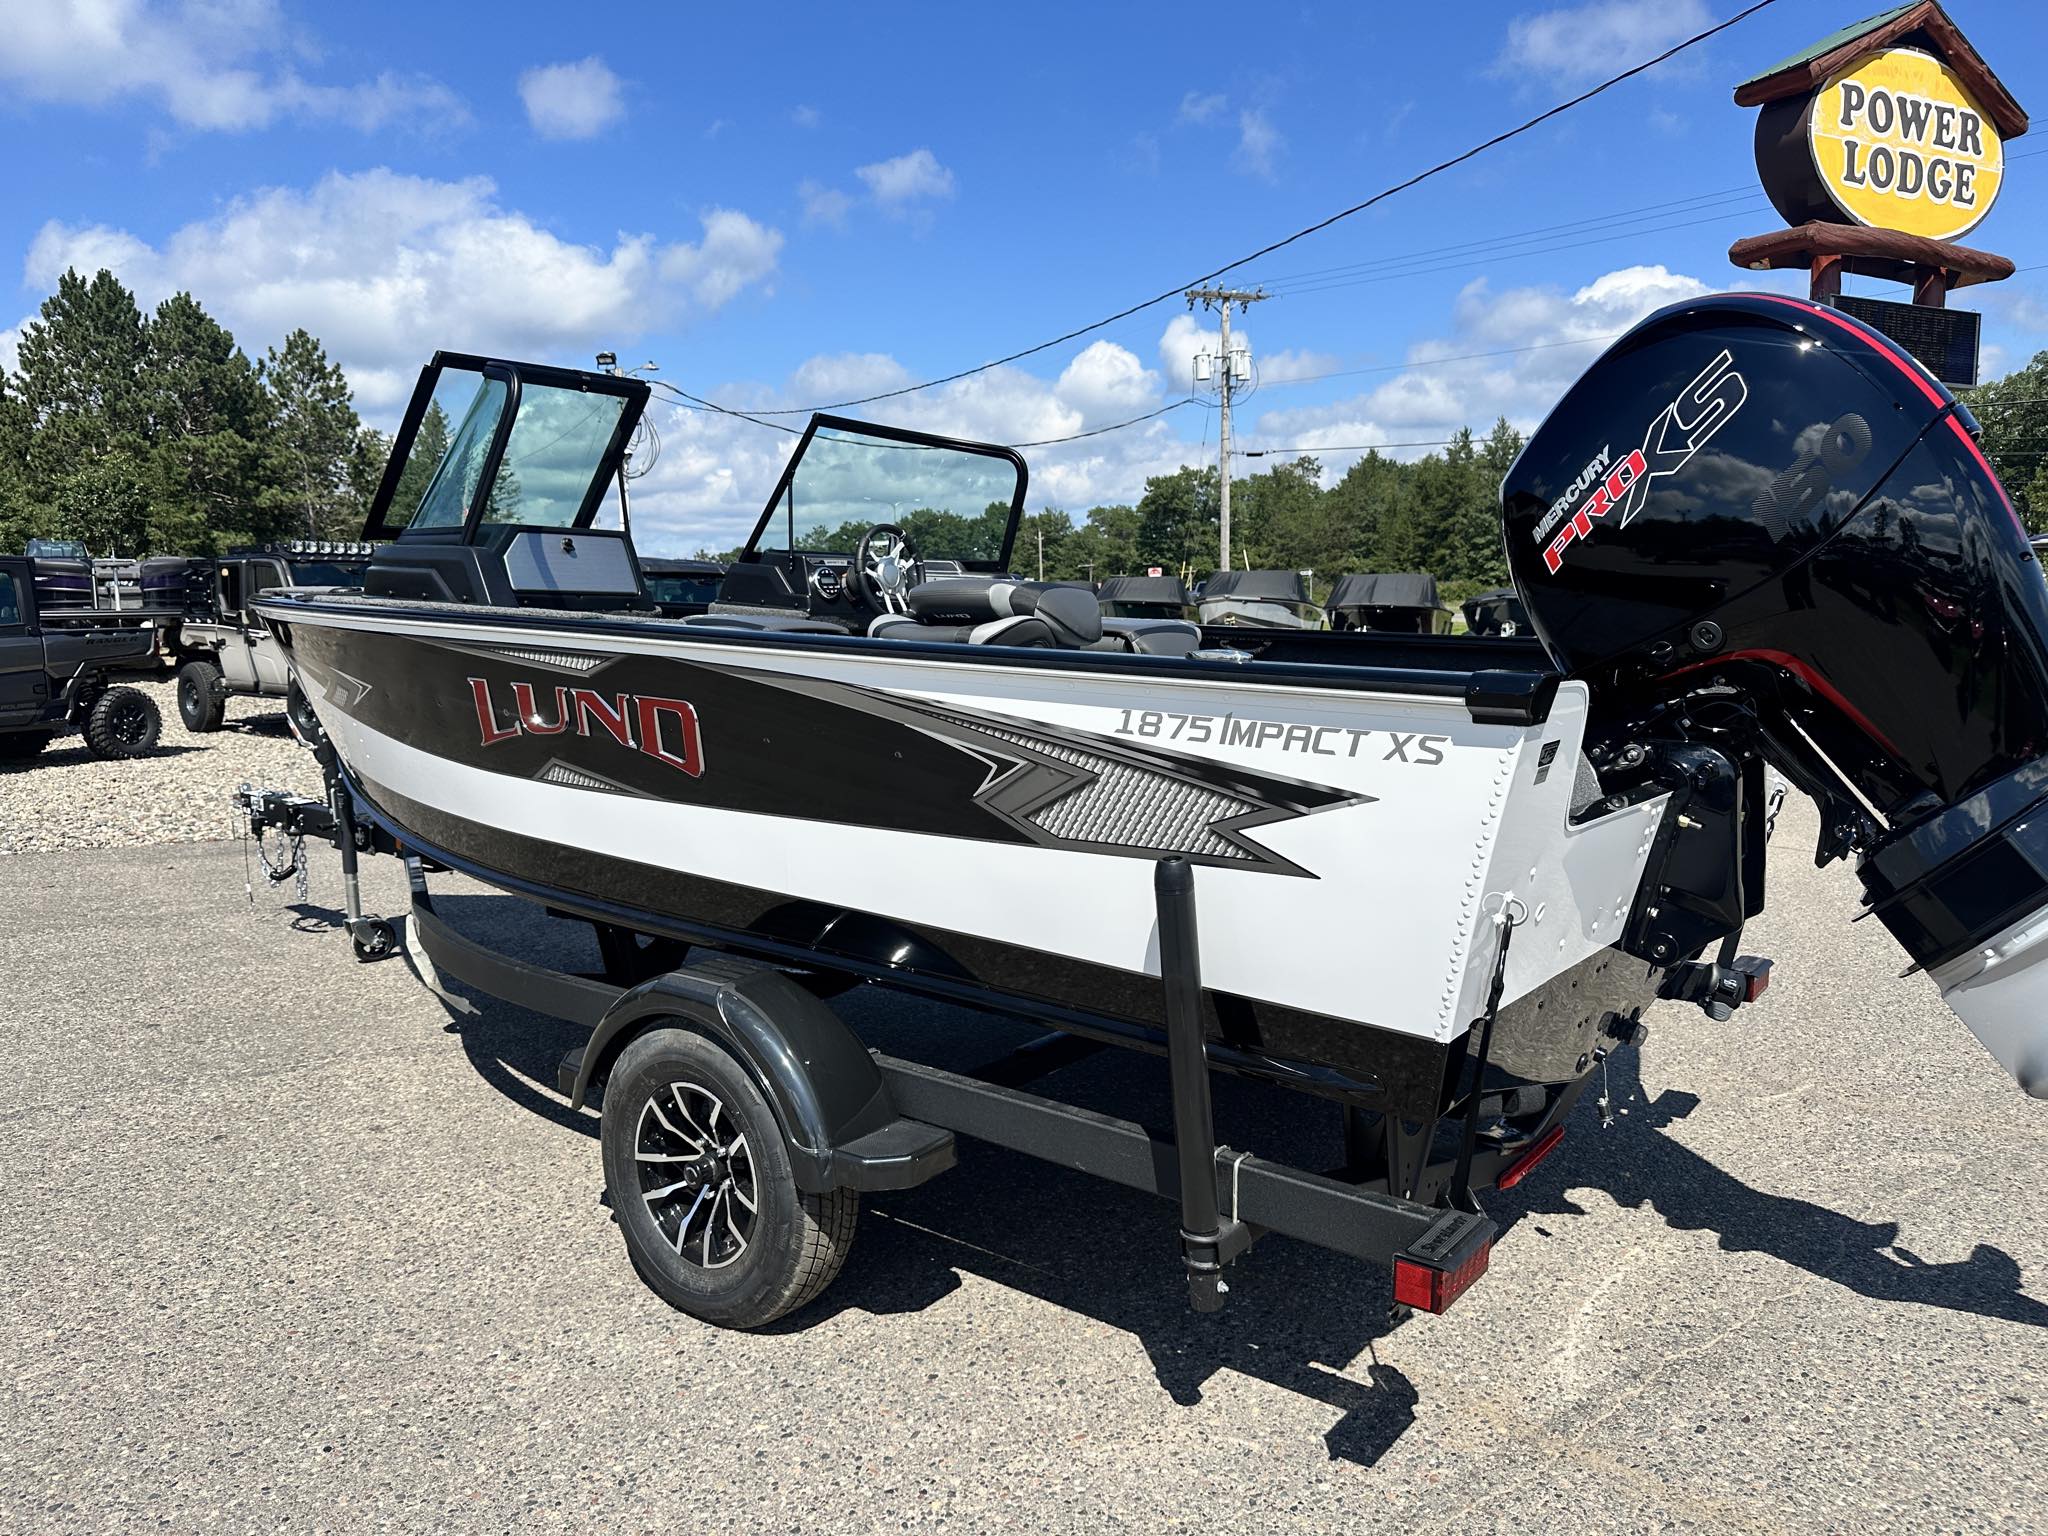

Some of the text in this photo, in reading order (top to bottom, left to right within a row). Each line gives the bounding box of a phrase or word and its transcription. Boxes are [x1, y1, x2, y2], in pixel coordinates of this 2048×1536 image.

[1840, 83, 1983, 156] POWER
[1843, 140, 1976, 206] LODGE
[1533, 445, 1612, 544] MERCURY
[467, 677, 705, 778] LUND
[1115, 709, 1449, 766] 1875 IMPACT XS
